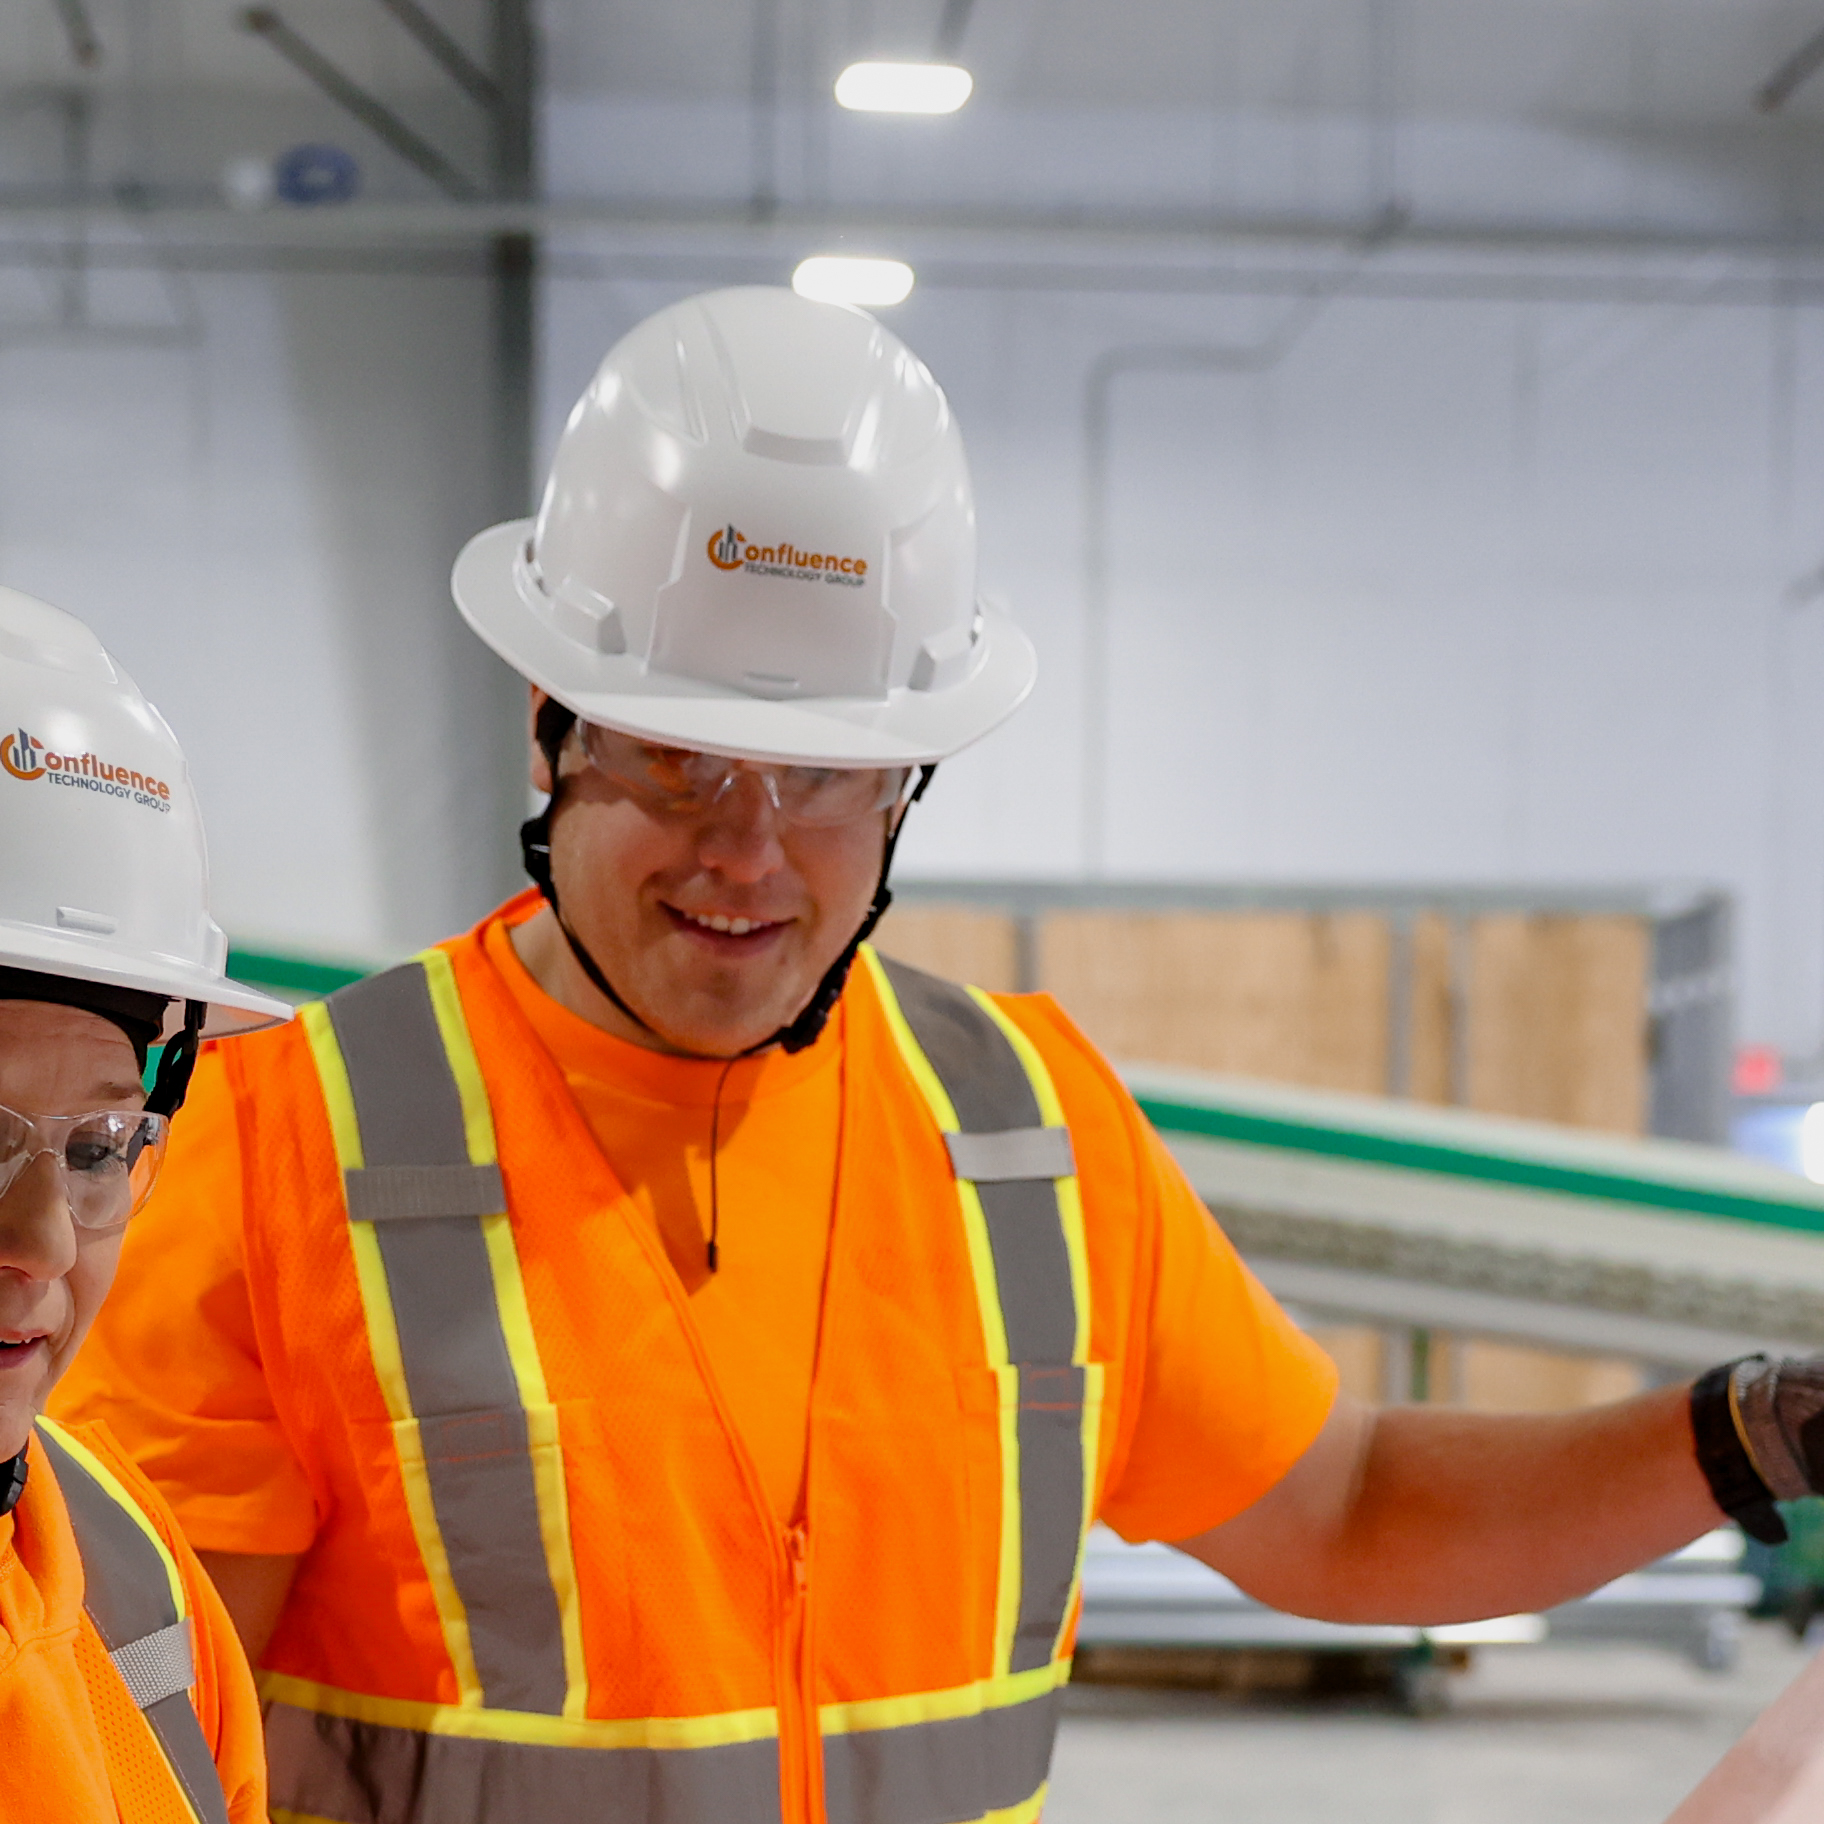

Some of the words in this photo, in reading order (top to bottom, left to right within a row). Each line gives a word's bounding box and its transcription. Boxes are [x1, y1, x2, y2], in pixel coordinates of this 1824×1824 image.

[707, 523, 868, 575] Confluence
[744, 562, 821, 582] TECHNOLOGY
[825, 571, 865, 588] GROUP
[47, 771, 131, 800] TECHNOLOGY
[134, 791, 171, 814] GROUP
